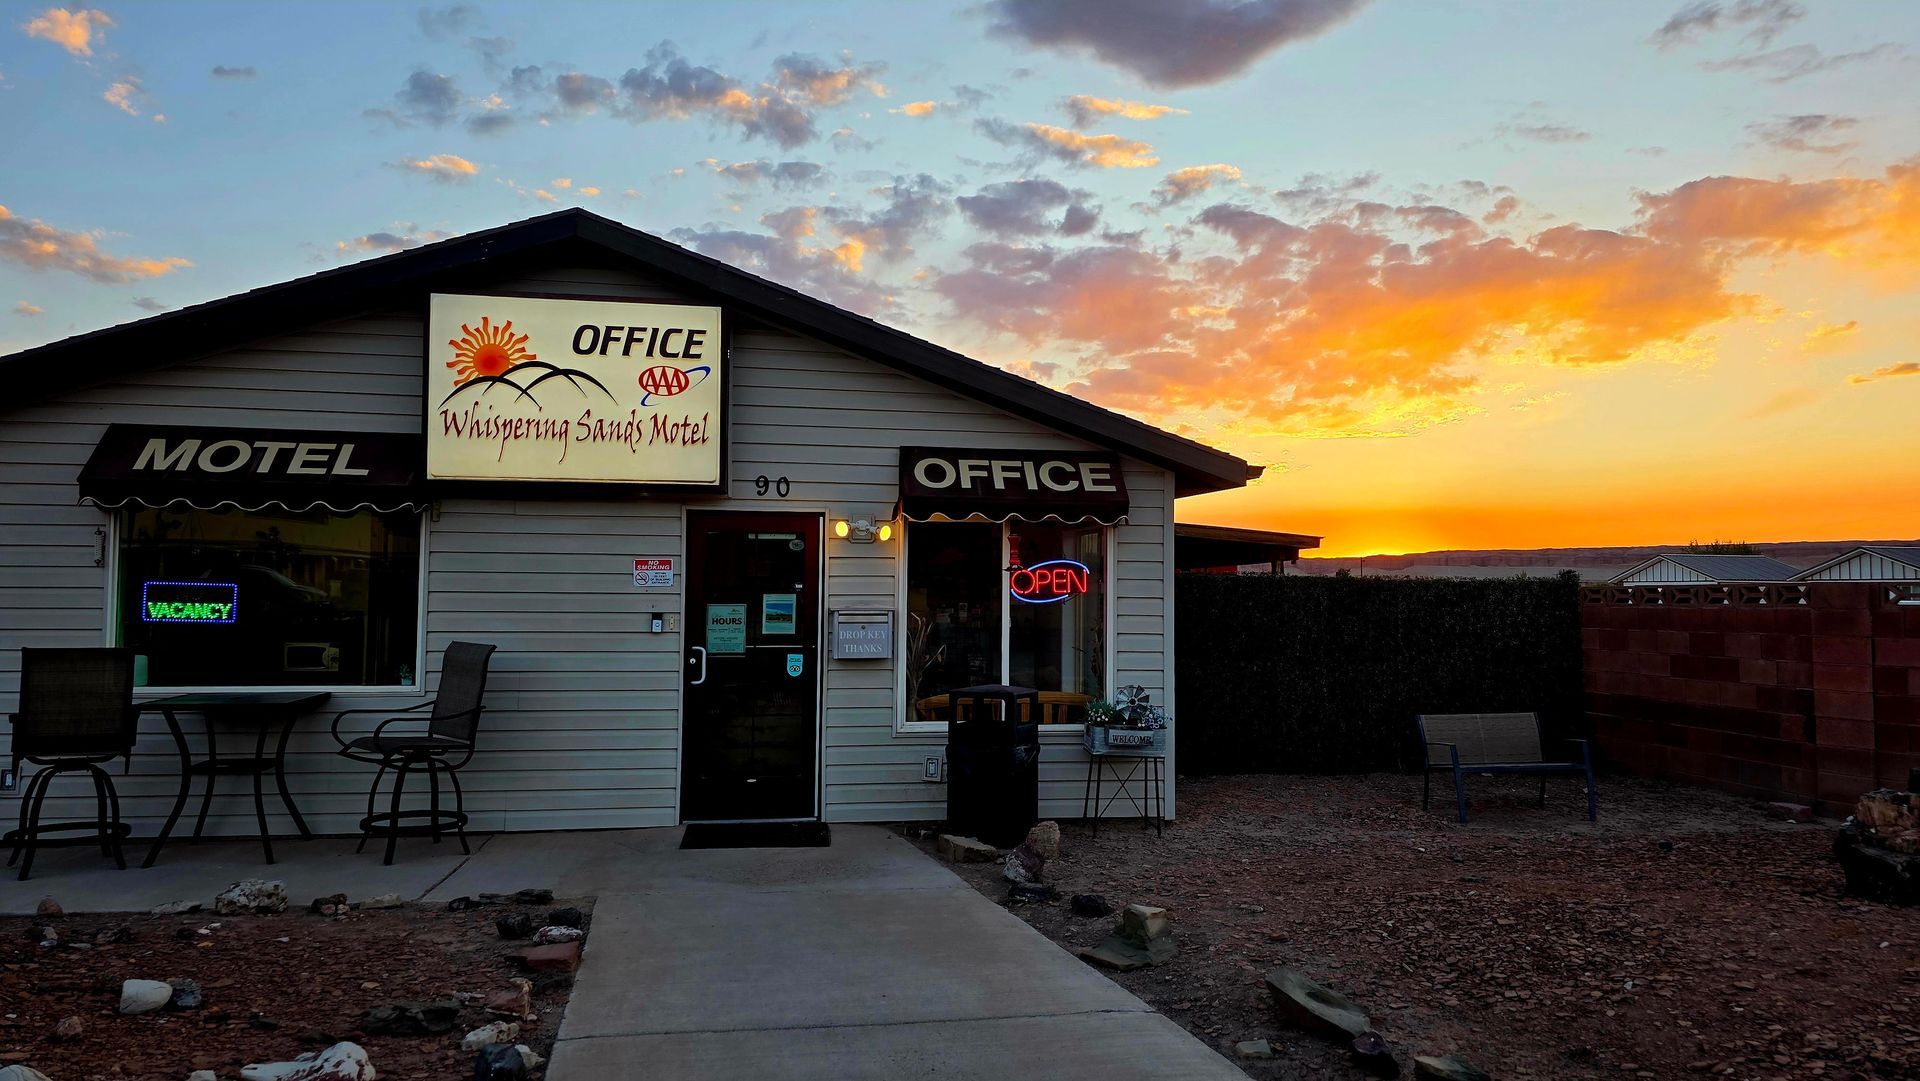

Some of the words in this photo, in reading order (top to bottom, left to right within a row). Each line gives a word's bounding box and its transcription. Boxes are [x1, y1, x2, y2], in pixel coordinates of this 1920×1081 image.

[572, 324, 707, 360] OFFICE
[643, 367, 686, 396] AAA
[439, 400, 571, 464] Whispering
[575, 408, 643, 454] Sands
[648, 411, 710, 447] Motel
[132, 438, 370, 477] MOTEL
[755, 474, 790, 498] 90
[913, 457, 1118, 493] OFFICE
[1011, 569, 1088, 595] OPEN
[147, 602, 233, 620] VACANCY
[711, 617, 743, 625] HOURS
[840, 630, 866, 640] DROP
[867, 630, 888, 639] KEY
[844, 644, 882, 653] THANKS
[1112, 734, 1153, 745] WELCOME
